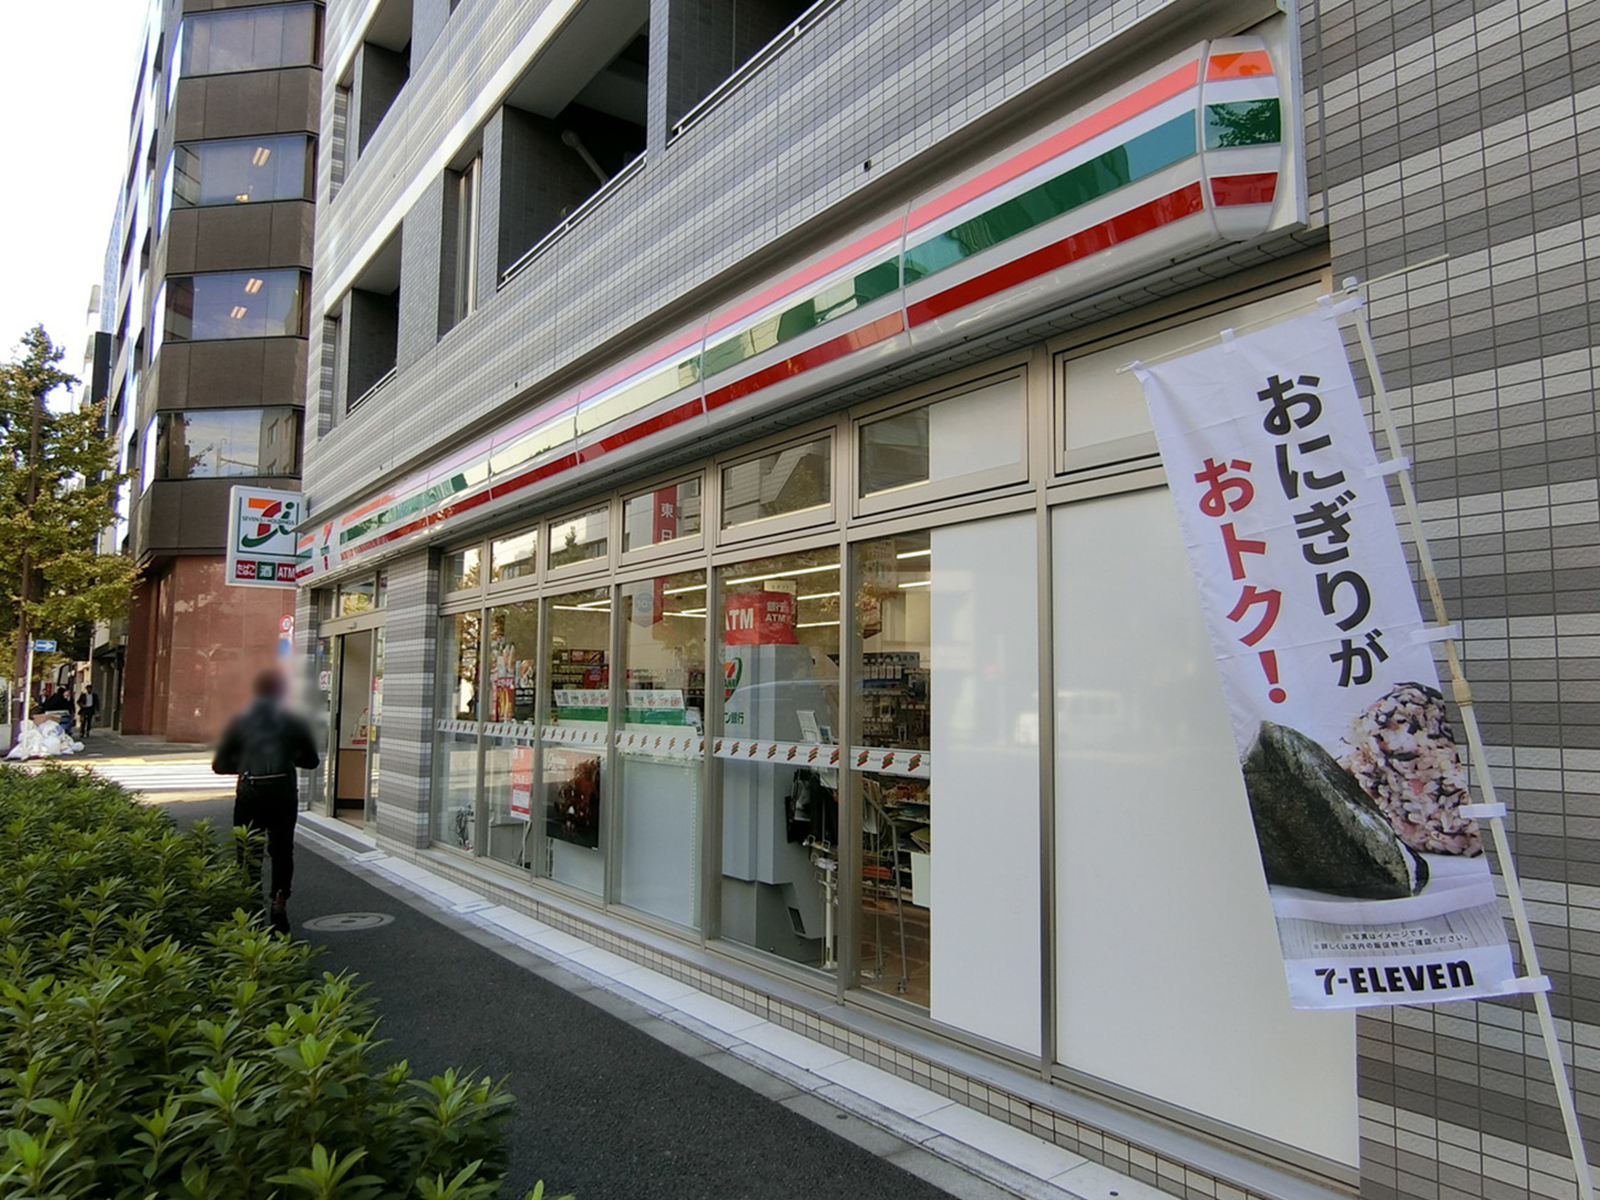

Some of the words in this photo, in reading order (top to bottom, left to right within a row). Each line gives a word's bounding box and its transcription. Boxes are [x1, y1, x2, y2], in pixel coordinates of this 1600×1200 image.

[236, 564, 256, 576] たばこ
[259, 564, 274, 578] 酒
[277, 566, 295, 579] ATM
[1194, 457, 1287, 704] おトク！
[1257, 375, 1389, 688] おにぎりが
[765, 613, 787, 622] ATM
